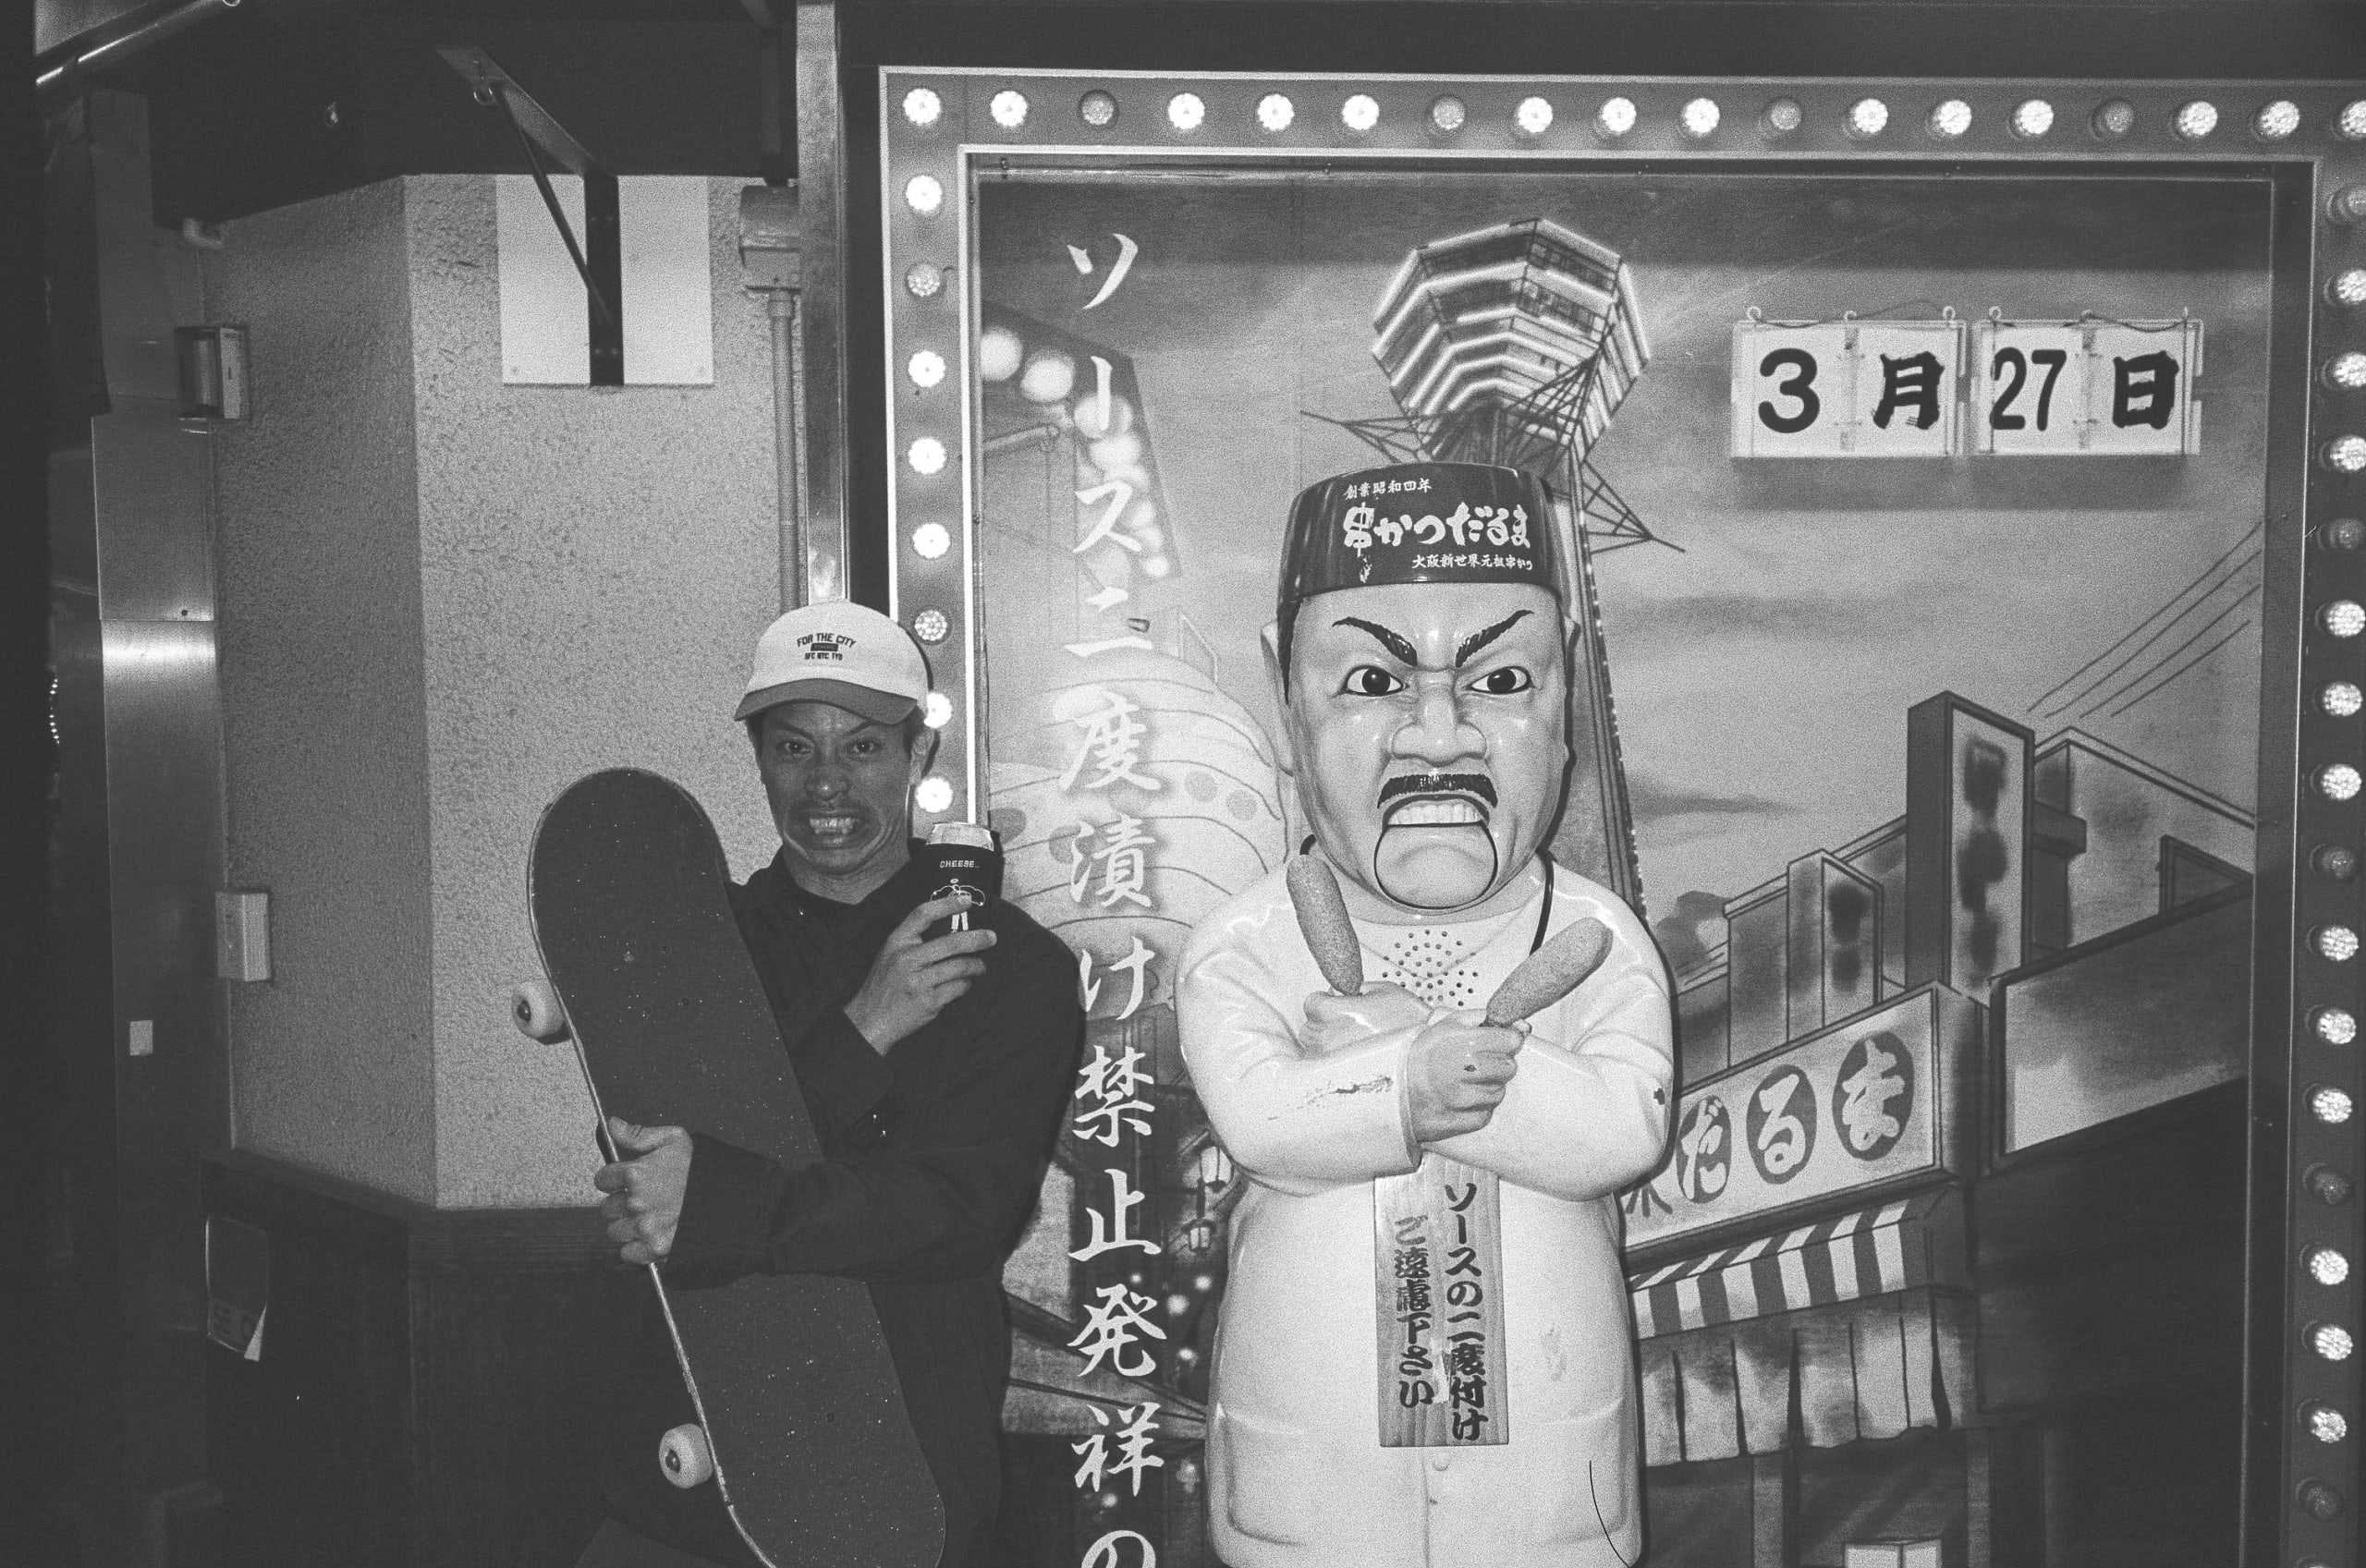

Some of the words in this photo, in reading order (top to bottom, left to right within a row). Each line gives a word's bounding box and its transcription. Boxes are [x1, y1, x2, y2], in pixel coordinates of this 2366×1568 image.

[1343, 478, 1433, 500] 創業昭和四年
[1343, 501, 1531, 557] 串かつだるま
[797, 634, 814, 647] FOR
[816, 633, 835, 642] THE
[835, 635, 857, 648] CITY
[1395, 1215, 1434, 1408] ご遠慮下さい
[1445, 1183, 1489, 1441] ソースの二度付け
